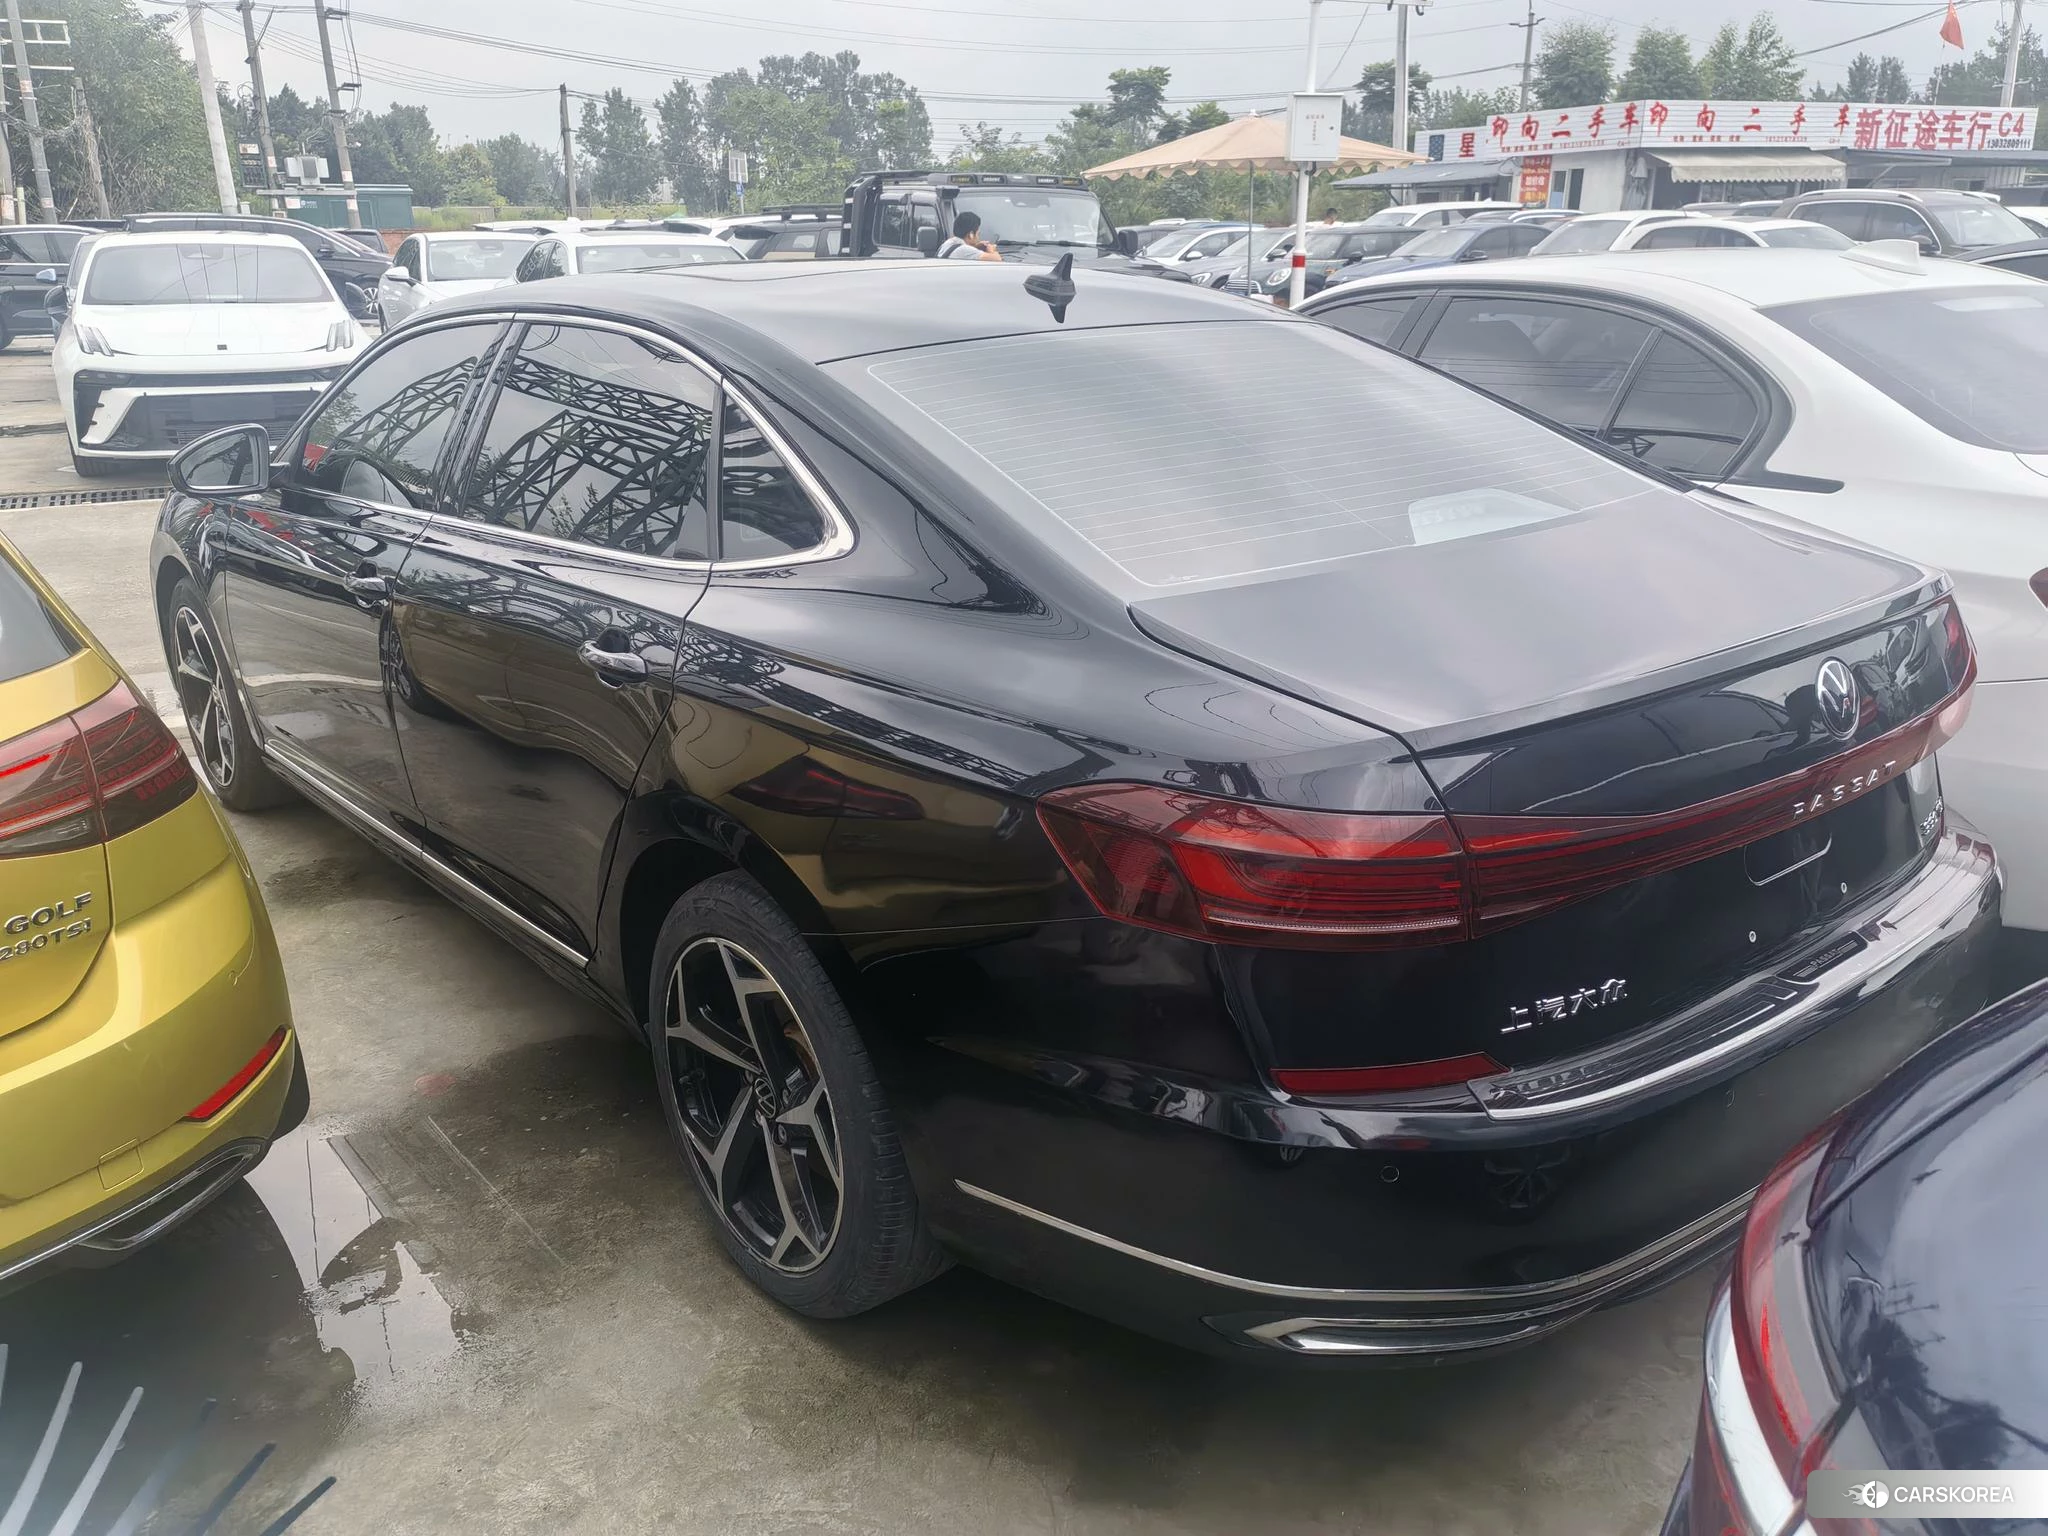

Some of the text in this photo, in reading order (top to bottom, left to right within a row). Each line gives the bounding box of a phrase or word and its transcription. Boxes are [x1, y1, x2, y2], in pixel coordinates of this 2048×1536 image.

[1854, 108, 2025, 150] 新征途车行 C4
[1793, 760, 1896, 819] PASSAT
[4, 891, 92, 934] GOLF
[0, 917, 92, 961] 280TSI
[1500, 978, 1627, 1034] 上汽大众
